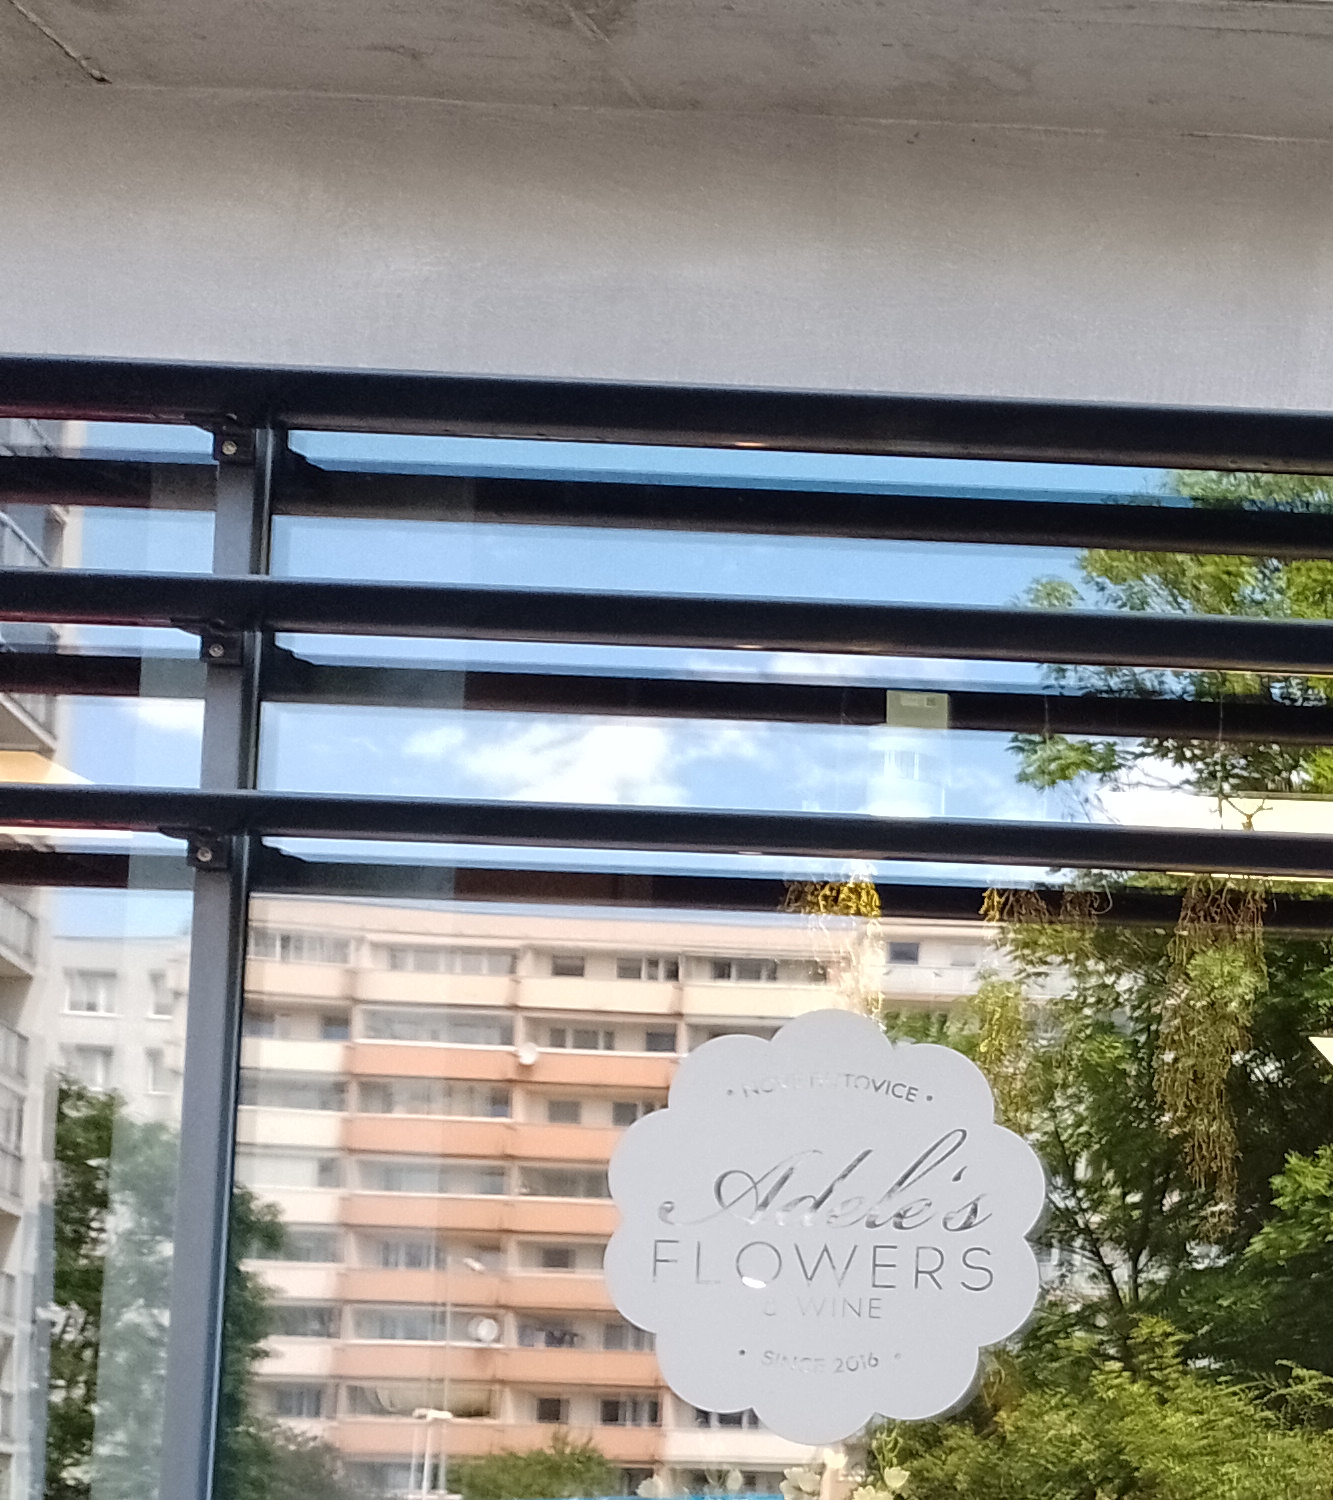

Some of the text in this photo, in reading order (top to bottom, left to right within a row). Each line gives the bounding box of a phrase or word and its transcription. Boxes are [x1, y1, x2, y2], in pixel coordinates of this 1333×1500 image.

[809, 1073, 919, 1103] BTOVICE
[658, 1128, 992, 1232] Adele's
[652, 1240, 994, 1292] FLOWERS
[797, 1297, 882, 1319] WINE
